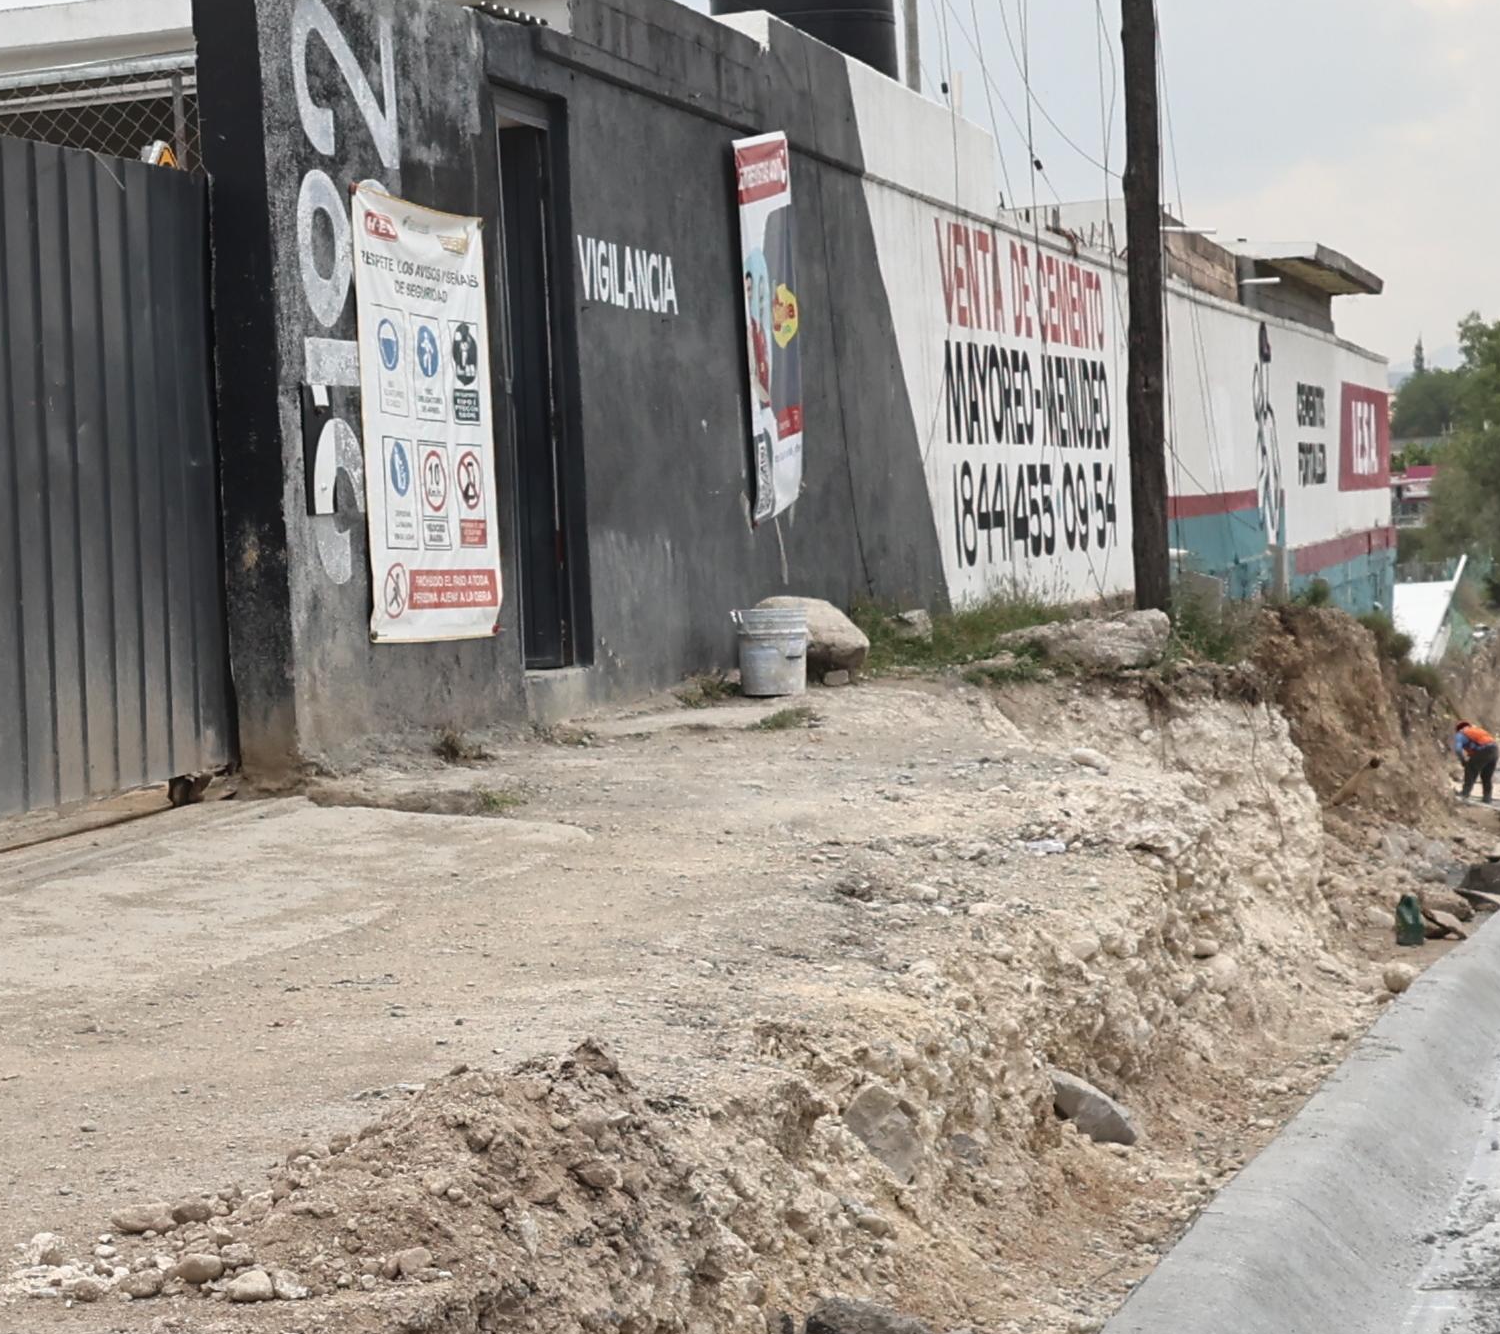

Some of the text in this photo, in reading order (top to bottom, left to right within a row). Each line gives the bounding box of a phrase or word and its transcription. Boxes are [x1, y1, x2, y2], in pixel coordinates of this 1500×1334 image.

[577, 234, 679, 315] VIGILANCIA
[934, 217, 1104, 352] VENTA DE CEMENTO
[428, 462, 440, 486] 10
